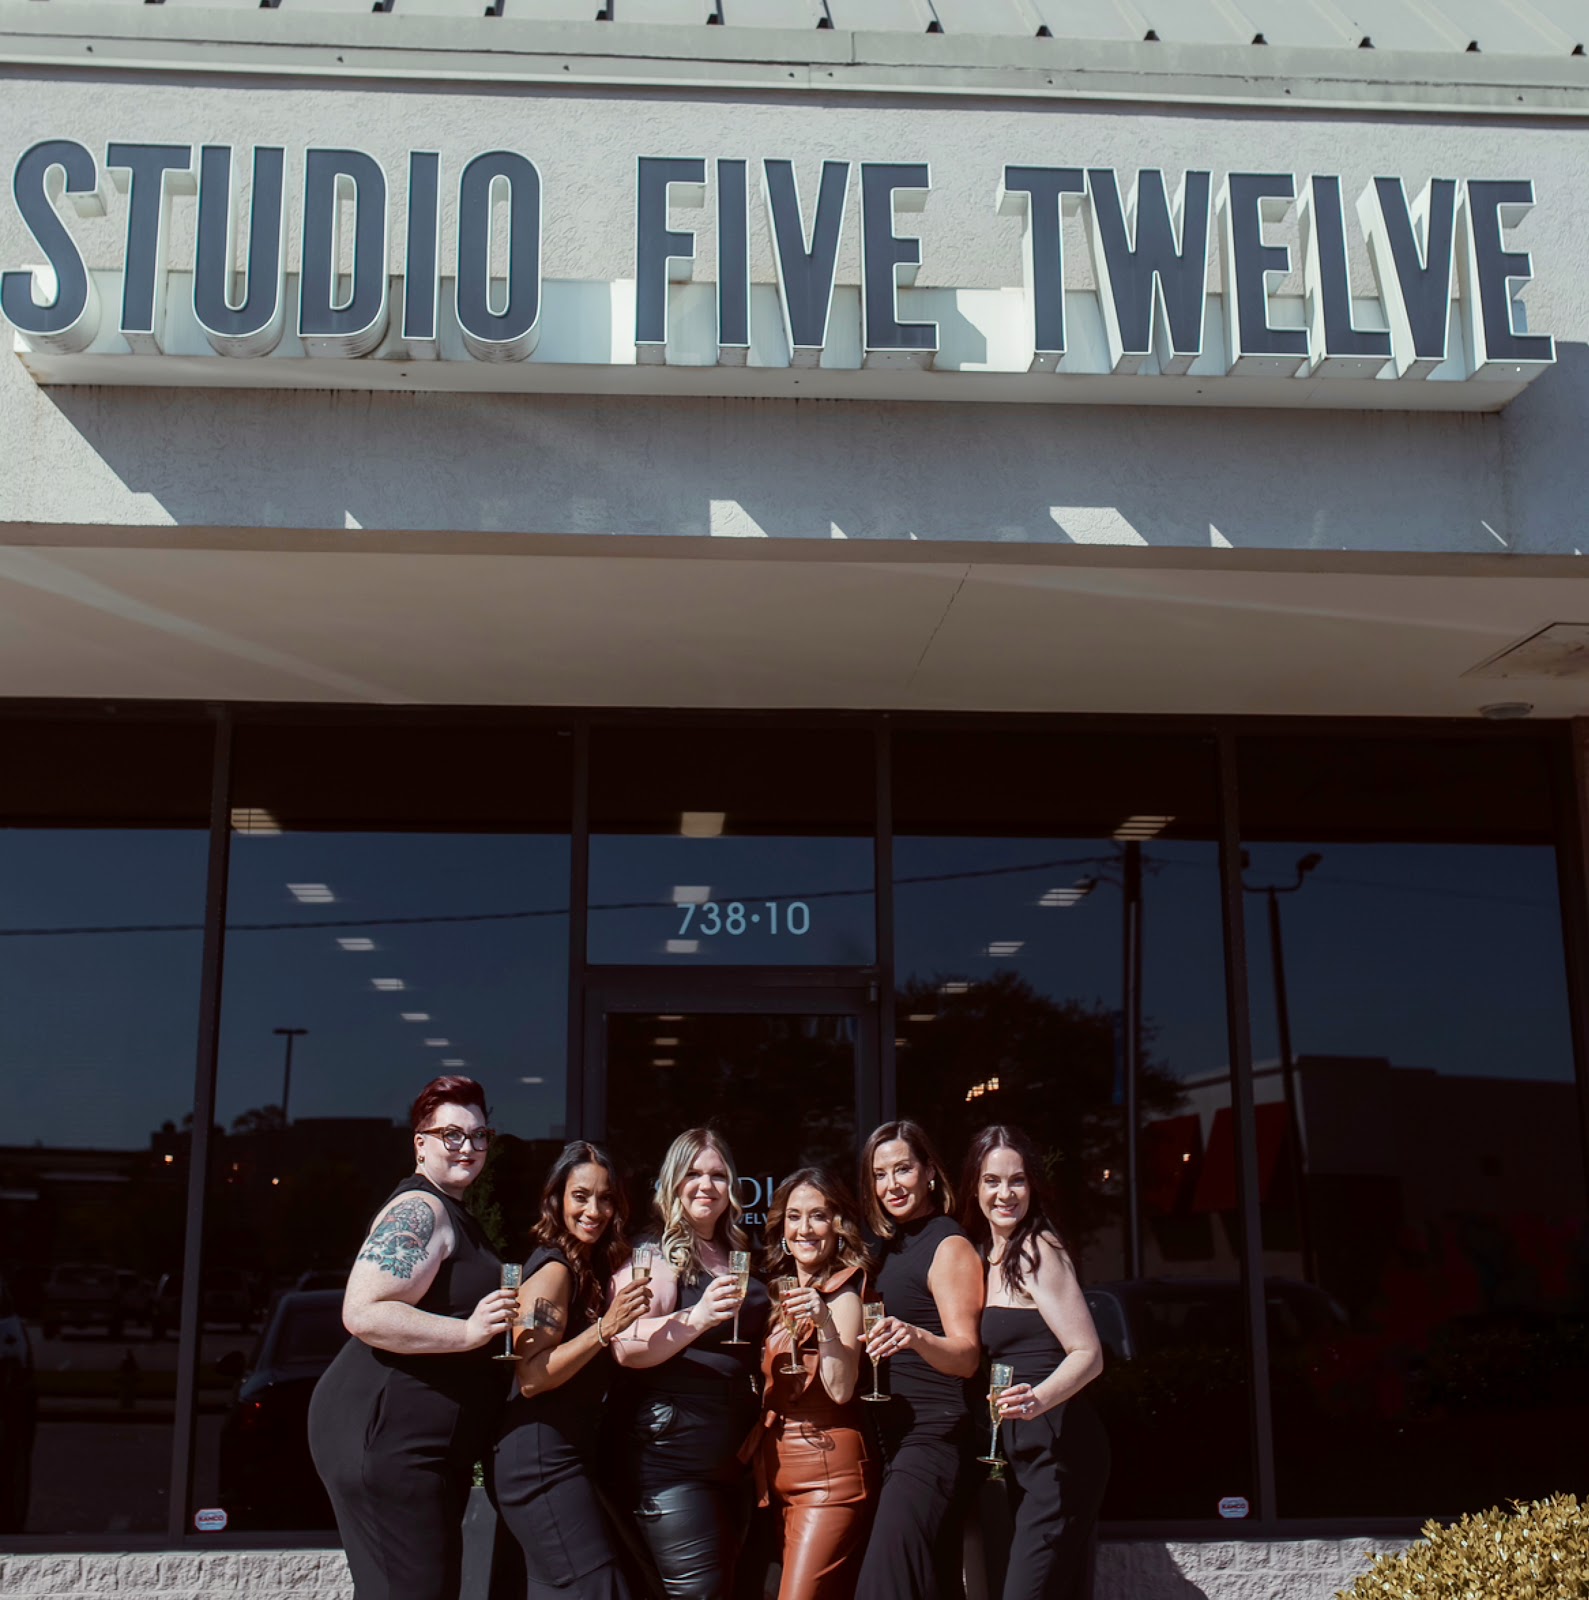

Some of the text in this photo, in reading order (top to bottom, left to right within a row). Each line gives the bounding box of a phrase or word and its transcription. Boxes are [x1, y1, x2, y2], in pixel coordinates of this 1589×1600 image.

[0, 138, 1556, 362] STUDIO FIVE TWELVE
